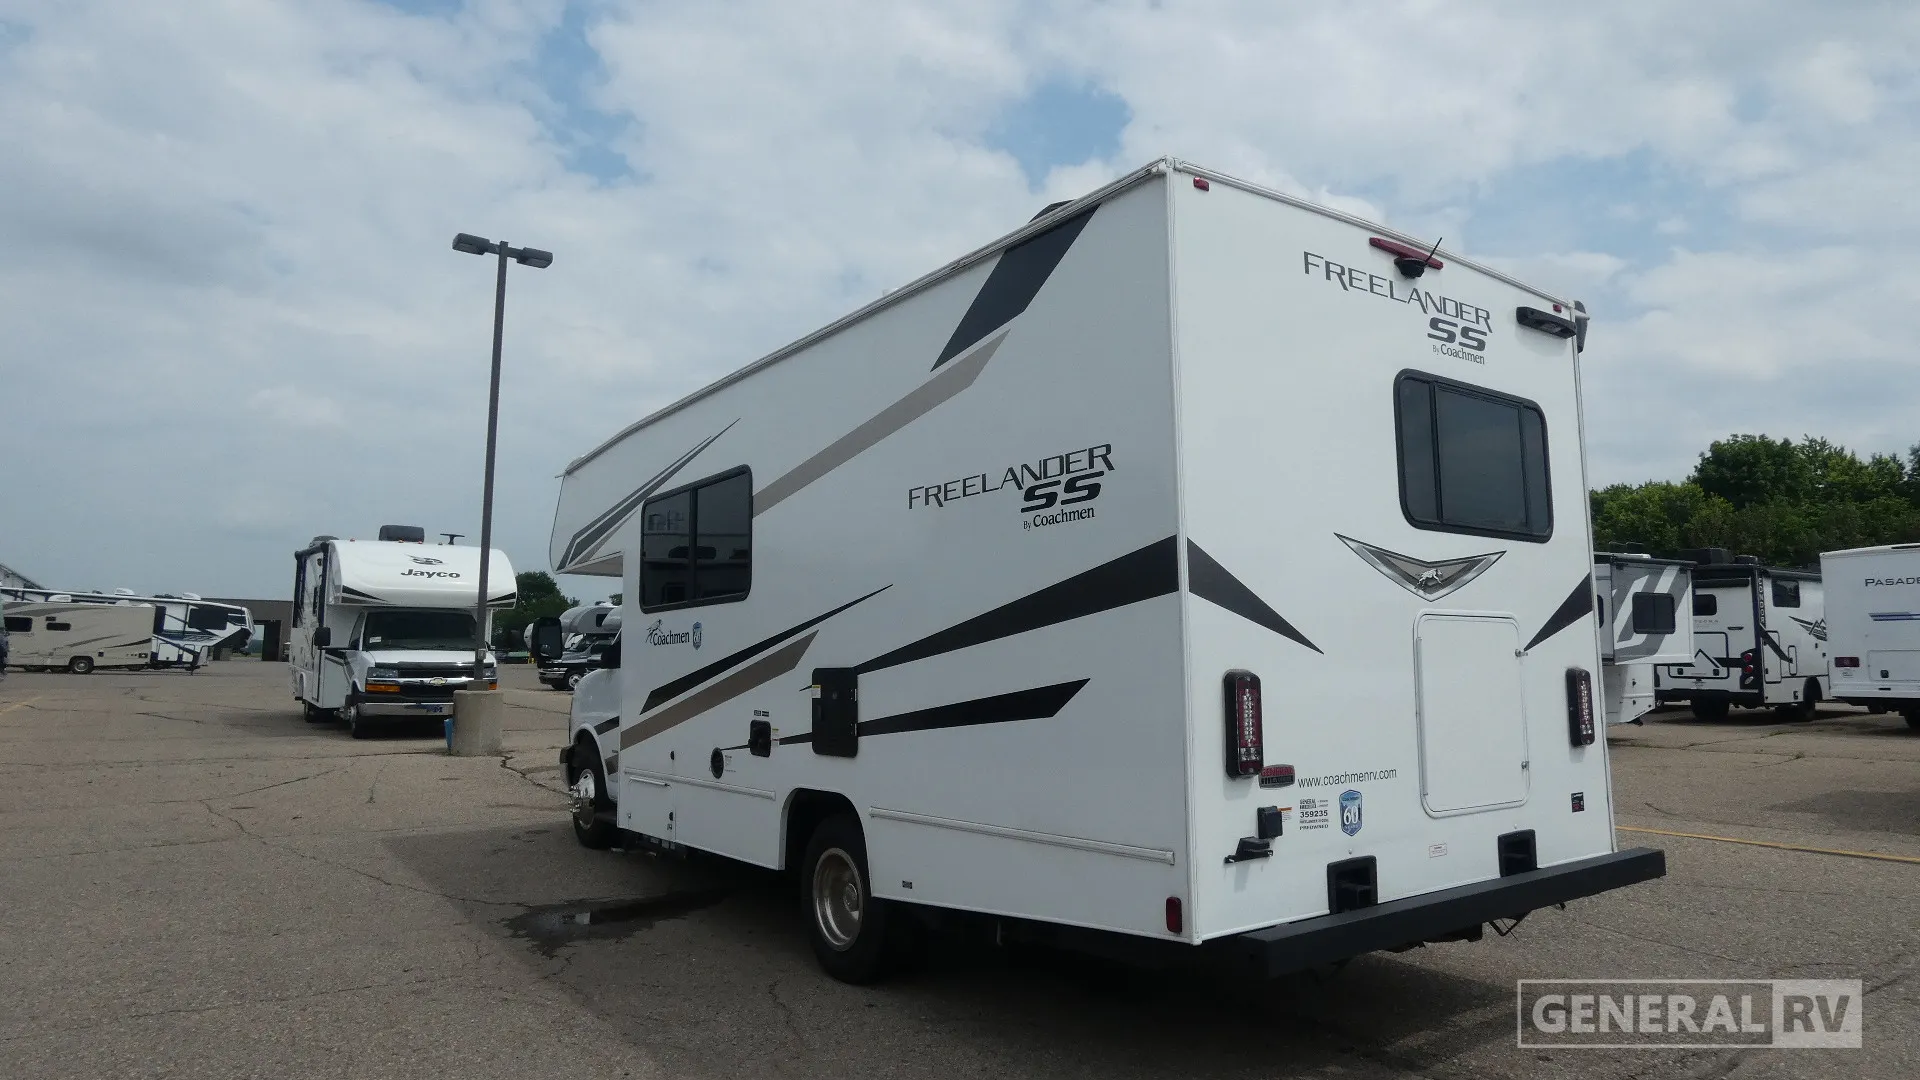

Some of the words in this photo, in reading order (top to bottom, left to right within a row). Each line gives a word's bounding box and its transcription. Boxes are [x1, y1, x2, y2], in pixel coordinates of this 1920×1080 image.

[1303, 250, 1493, 334] FREELANDER
[1427, 316, 1487, 352] SS
[1440, 343, 1485, 365] Coachmen
[908, 443, 1116, 510] FREELANDER
[1020, 470, 1105, 514] SS
[1023, 520, 1032, 531] By
[1033, 507, 1095, 528] Coachmen
[400, 568, 461, 579] Jayco
[652, 629, 690, 646] Coachmen
[1297, 768, 1397, 789] www.coachmenrv.com
[1299, 809, 1329, 819] 359235
[1343, 805, 1359, 825] 60
